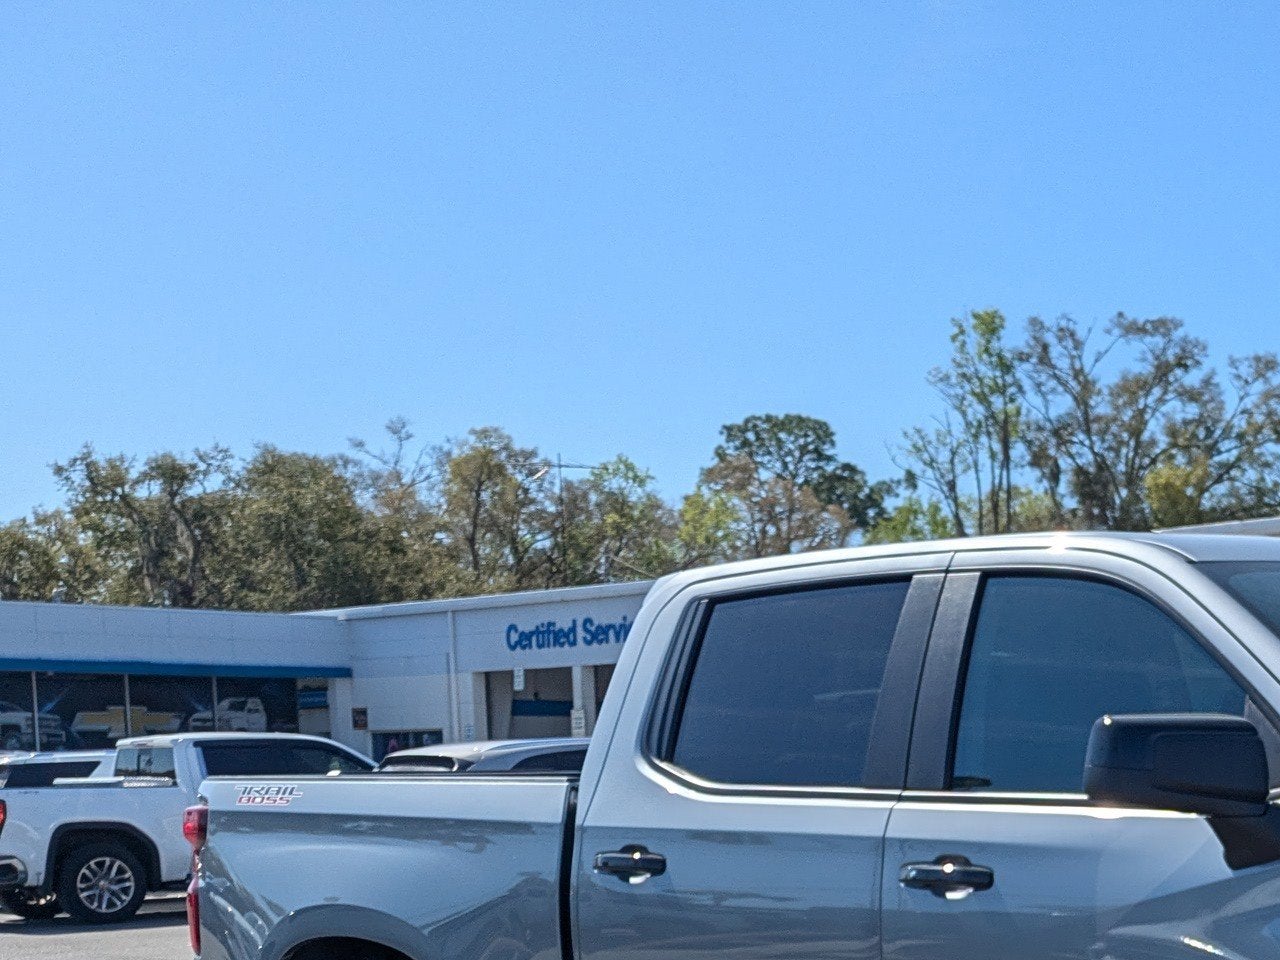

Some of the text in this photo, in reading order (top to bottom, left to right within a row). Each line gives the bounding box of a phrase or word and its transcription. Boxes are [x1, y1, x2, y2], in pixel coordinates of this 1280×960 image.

[506, 619, 577, 651] Certified
[235, 785, 303, 797] TRAIL
[237, 796, 293, 806] BOSS
